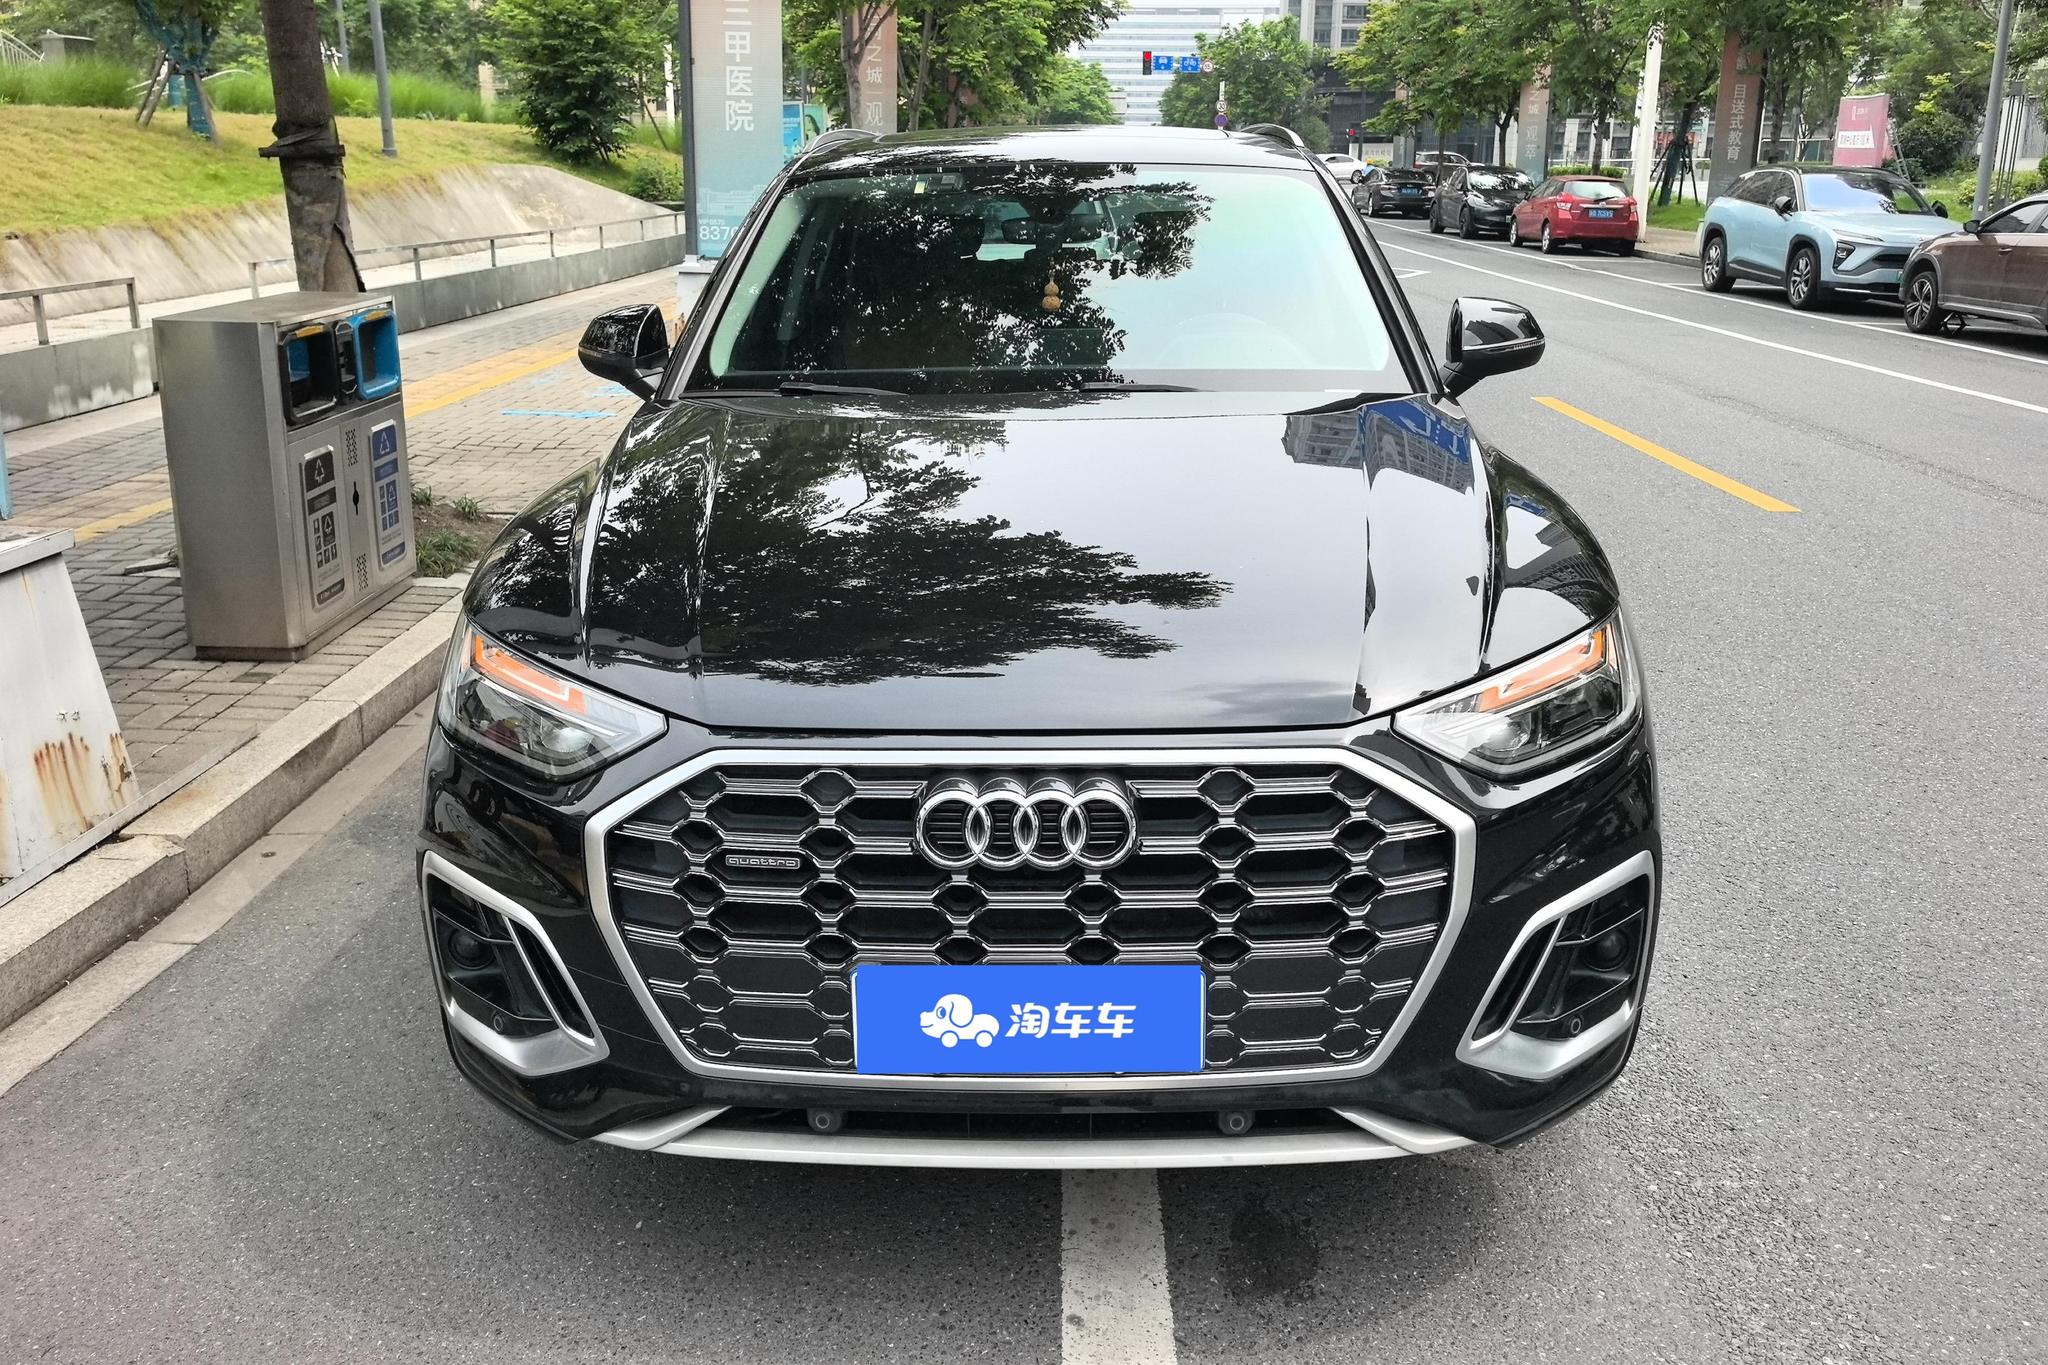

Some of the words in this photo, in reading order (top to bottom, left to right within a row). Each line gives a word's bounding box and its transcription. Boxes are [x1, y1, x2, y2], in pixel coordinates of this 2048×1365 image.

[722, 0, 754, 132] 三甲医院
[729, 857, 796, 867] quattro
